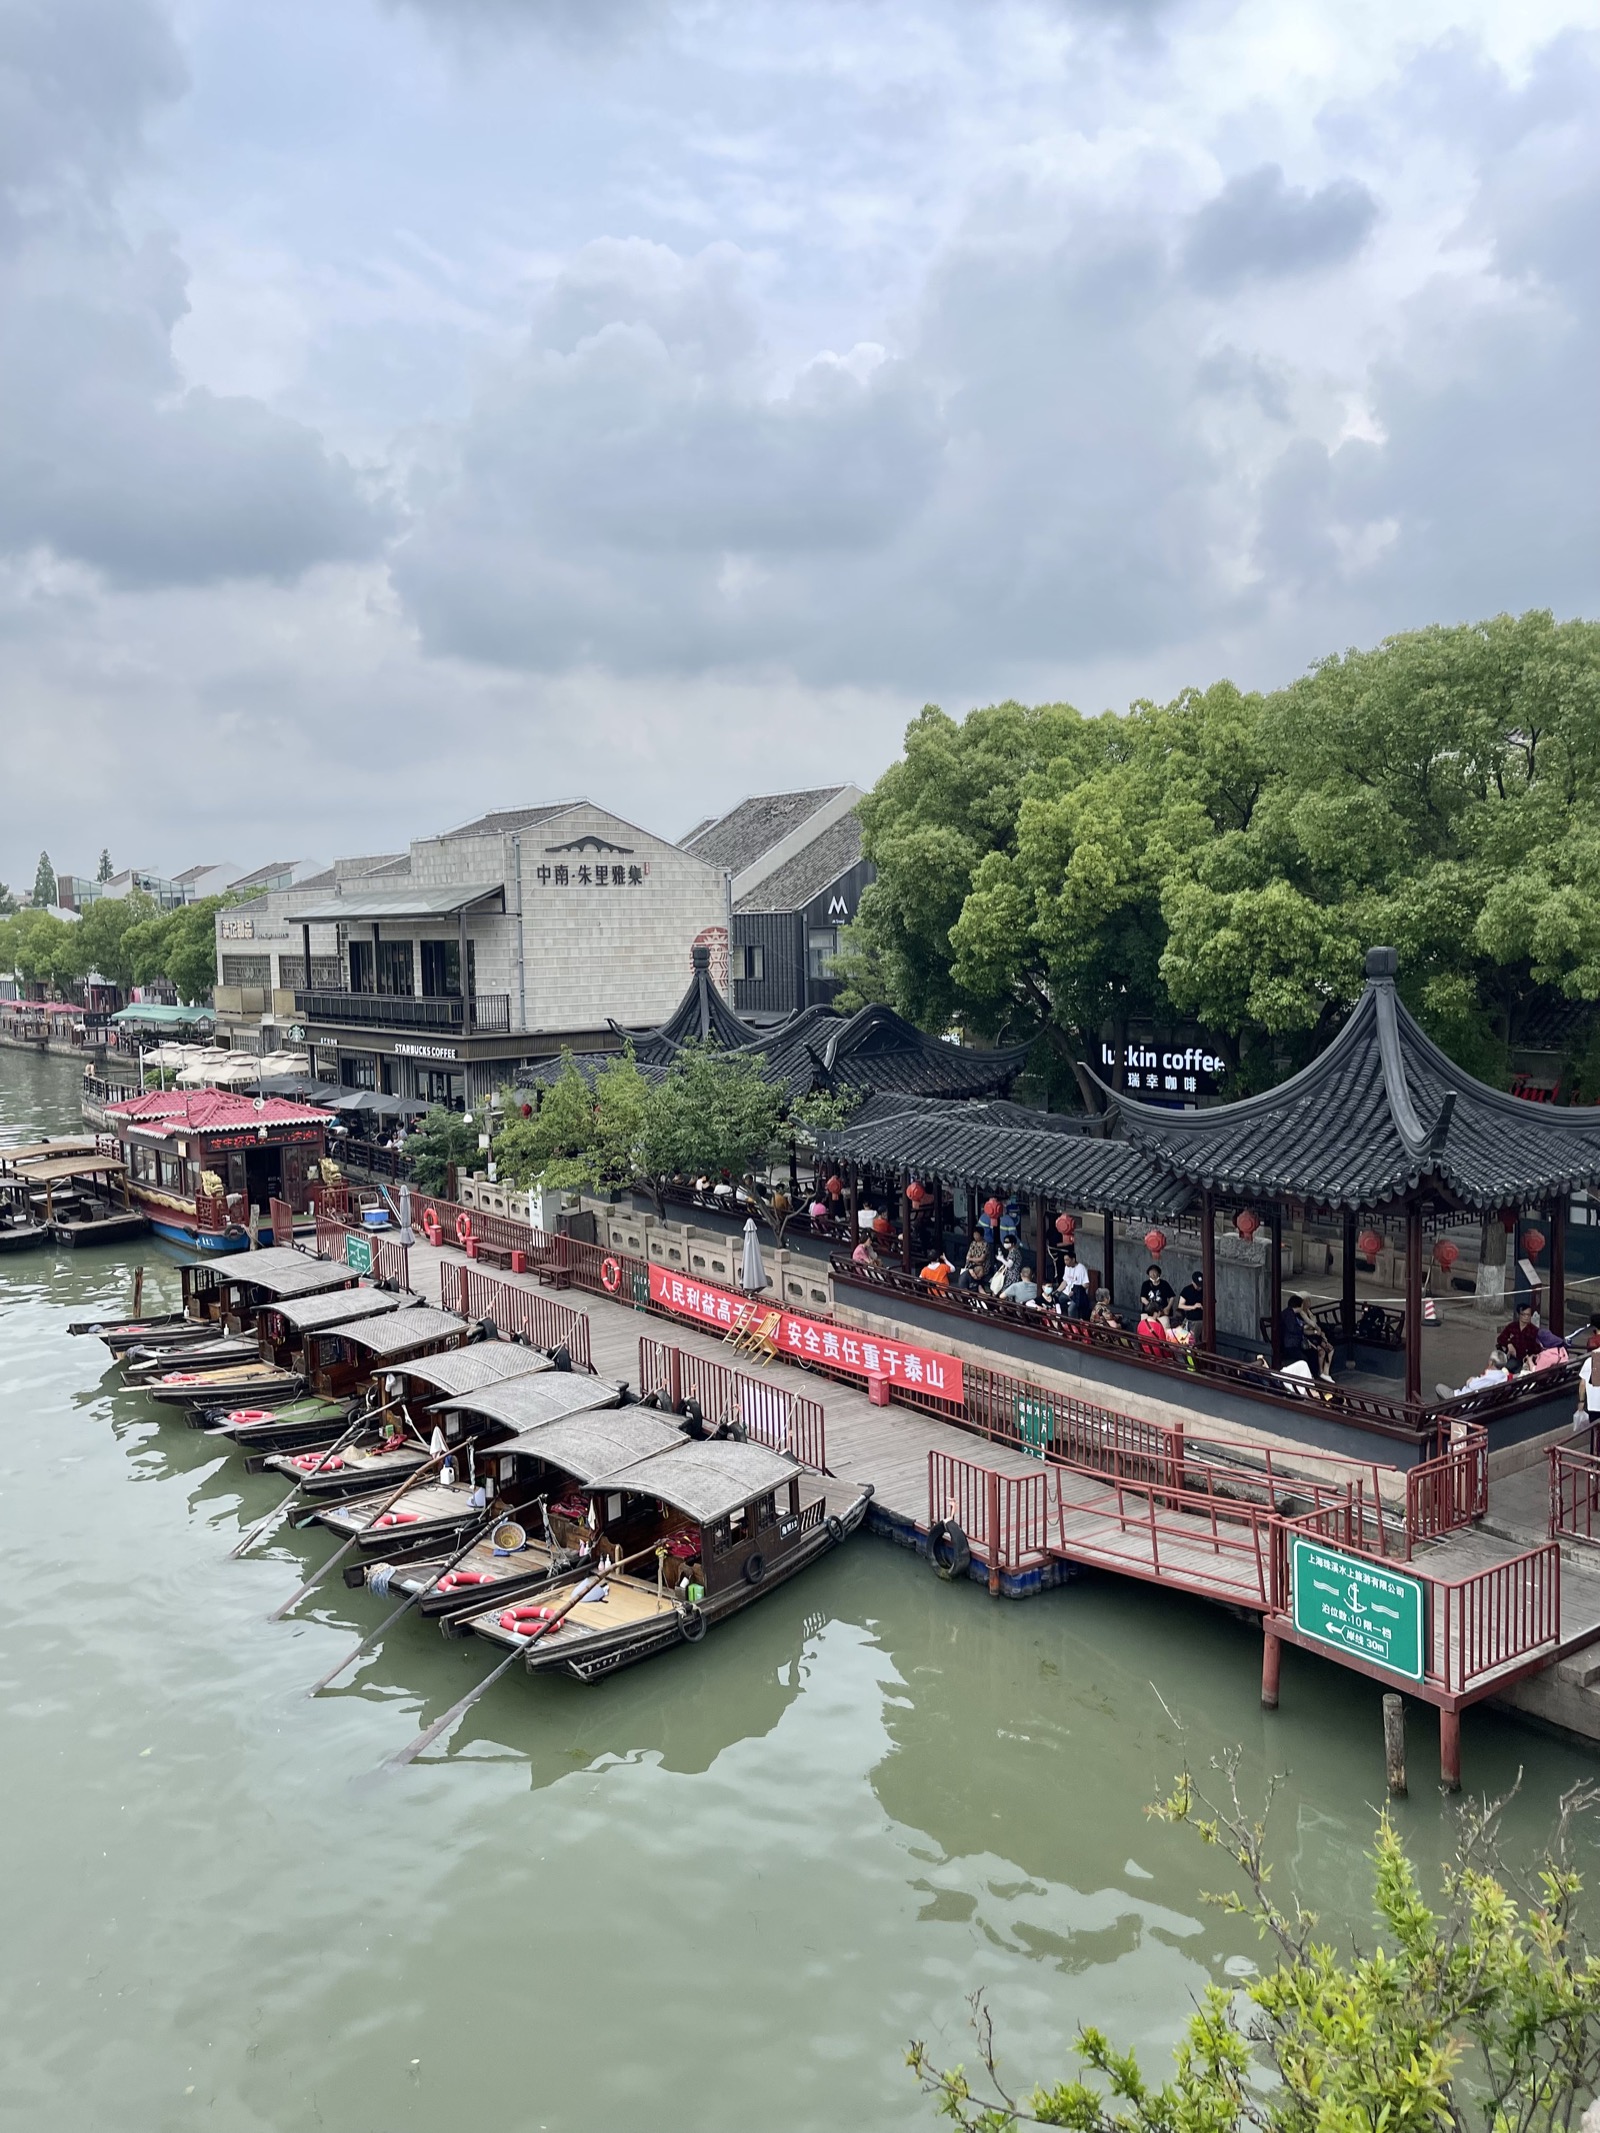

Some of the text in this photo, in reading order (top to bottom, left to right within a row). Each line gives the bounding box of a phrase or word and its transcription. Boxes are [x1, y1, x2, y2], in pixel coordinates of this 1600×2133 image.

[536, 864, 643, 886] 中南·朱里雅集
[394, 1043, 456, 1059] STARBUCKS COFFEE
[1162, 1048, 1226, 1072] coffee
[1127, 1072, 1197, 1092] 瑞幸咖啡
[788, 1321, 944, 1389] 安全责任重于泰山
[1307, 1553, 1405, 1599] 上海珠溪水上旅游有限公司
[1366, 1638, 1385, 1653] 30m
